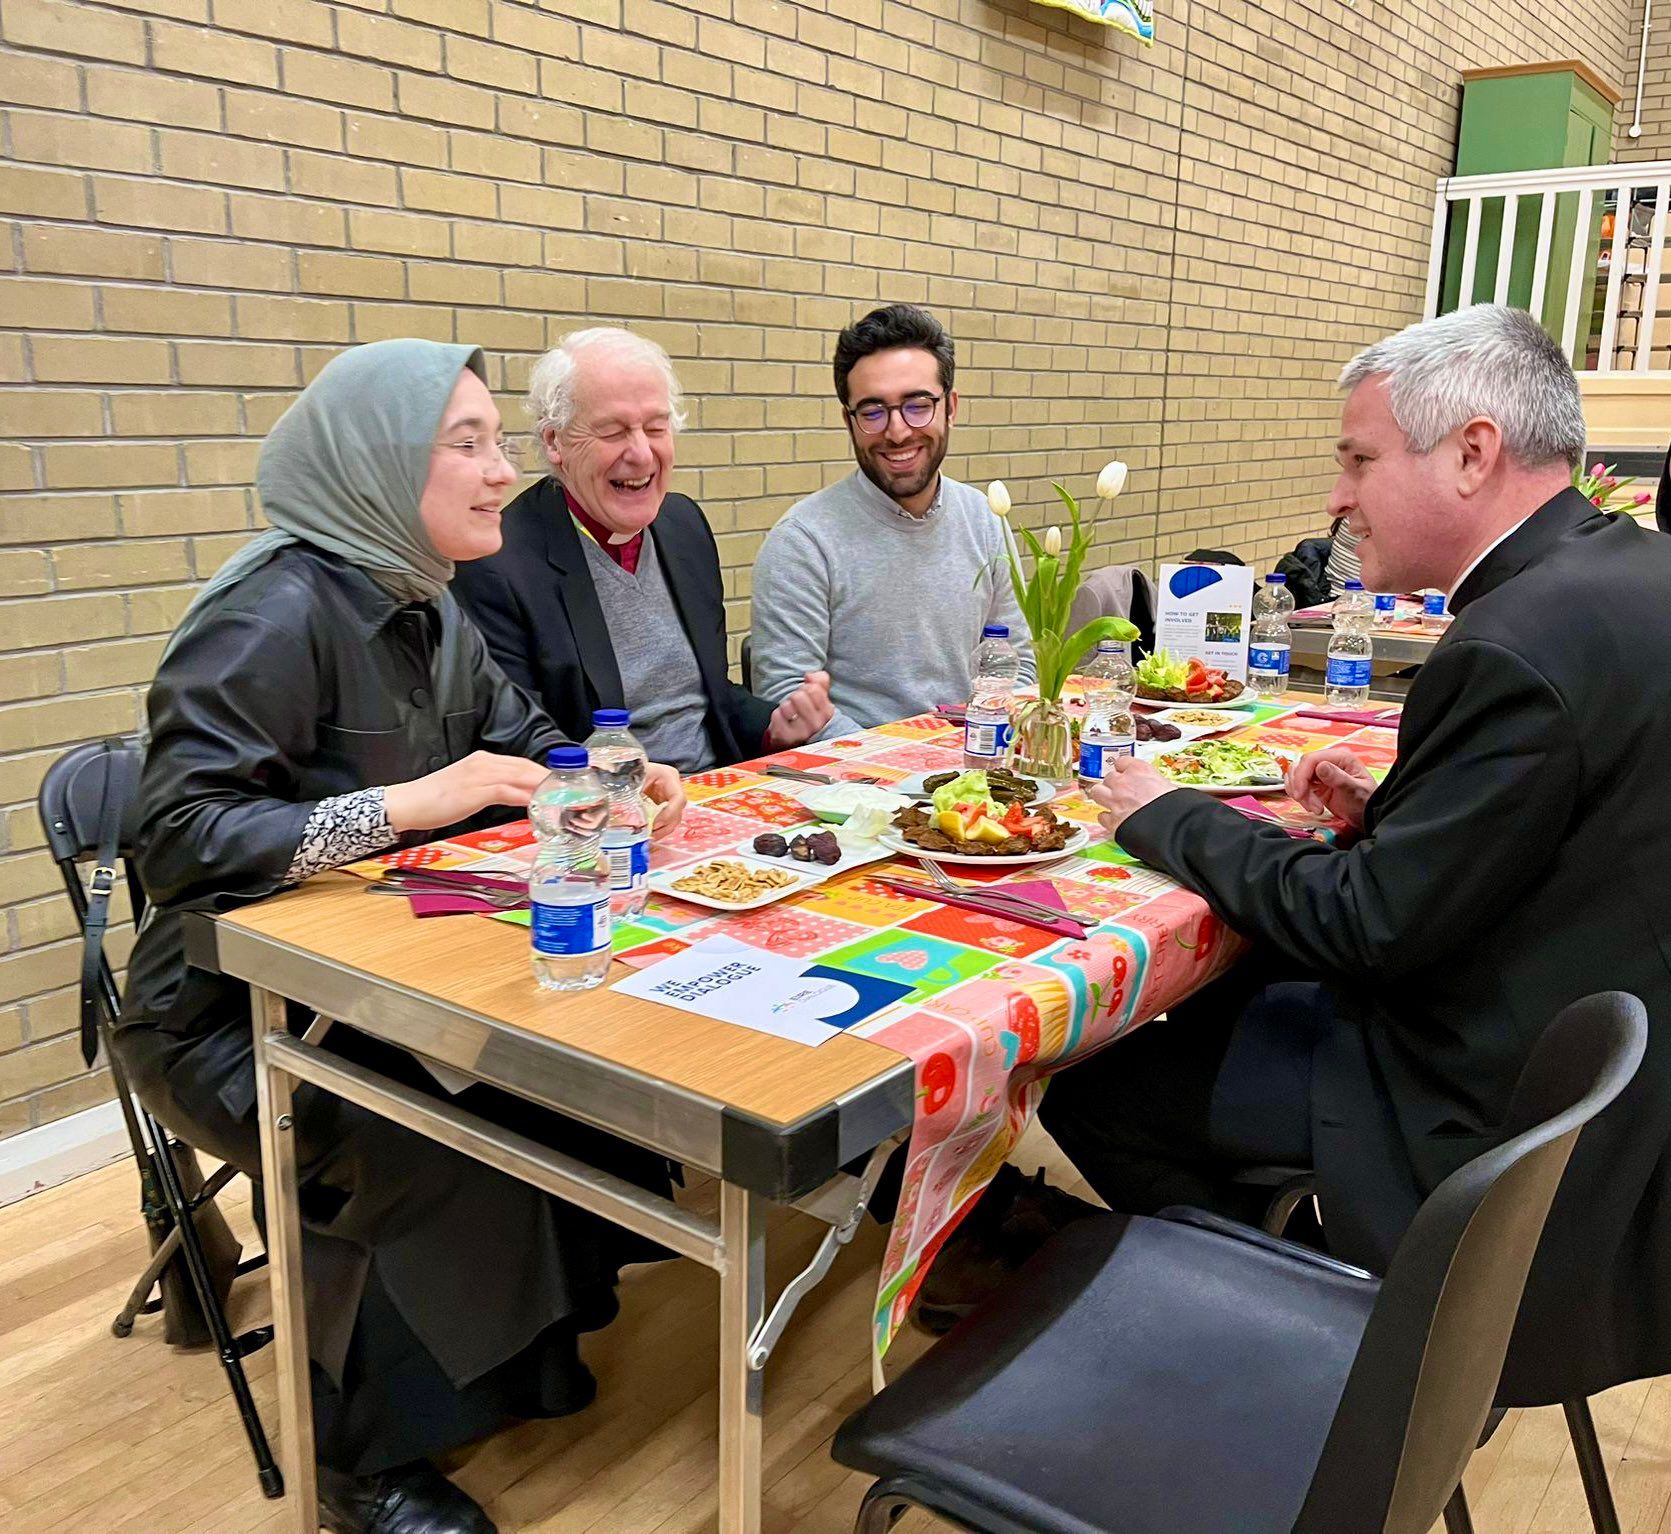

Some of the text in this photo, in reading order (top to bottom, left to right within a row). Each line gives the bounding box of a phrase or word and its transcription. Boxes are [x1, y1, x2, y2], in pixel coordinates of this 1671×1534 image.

[649, 979, 682, 993] WE
[665, 962, 747, 998] EMPOWER
[679, 965, 761, 1002] DIALOGUE
